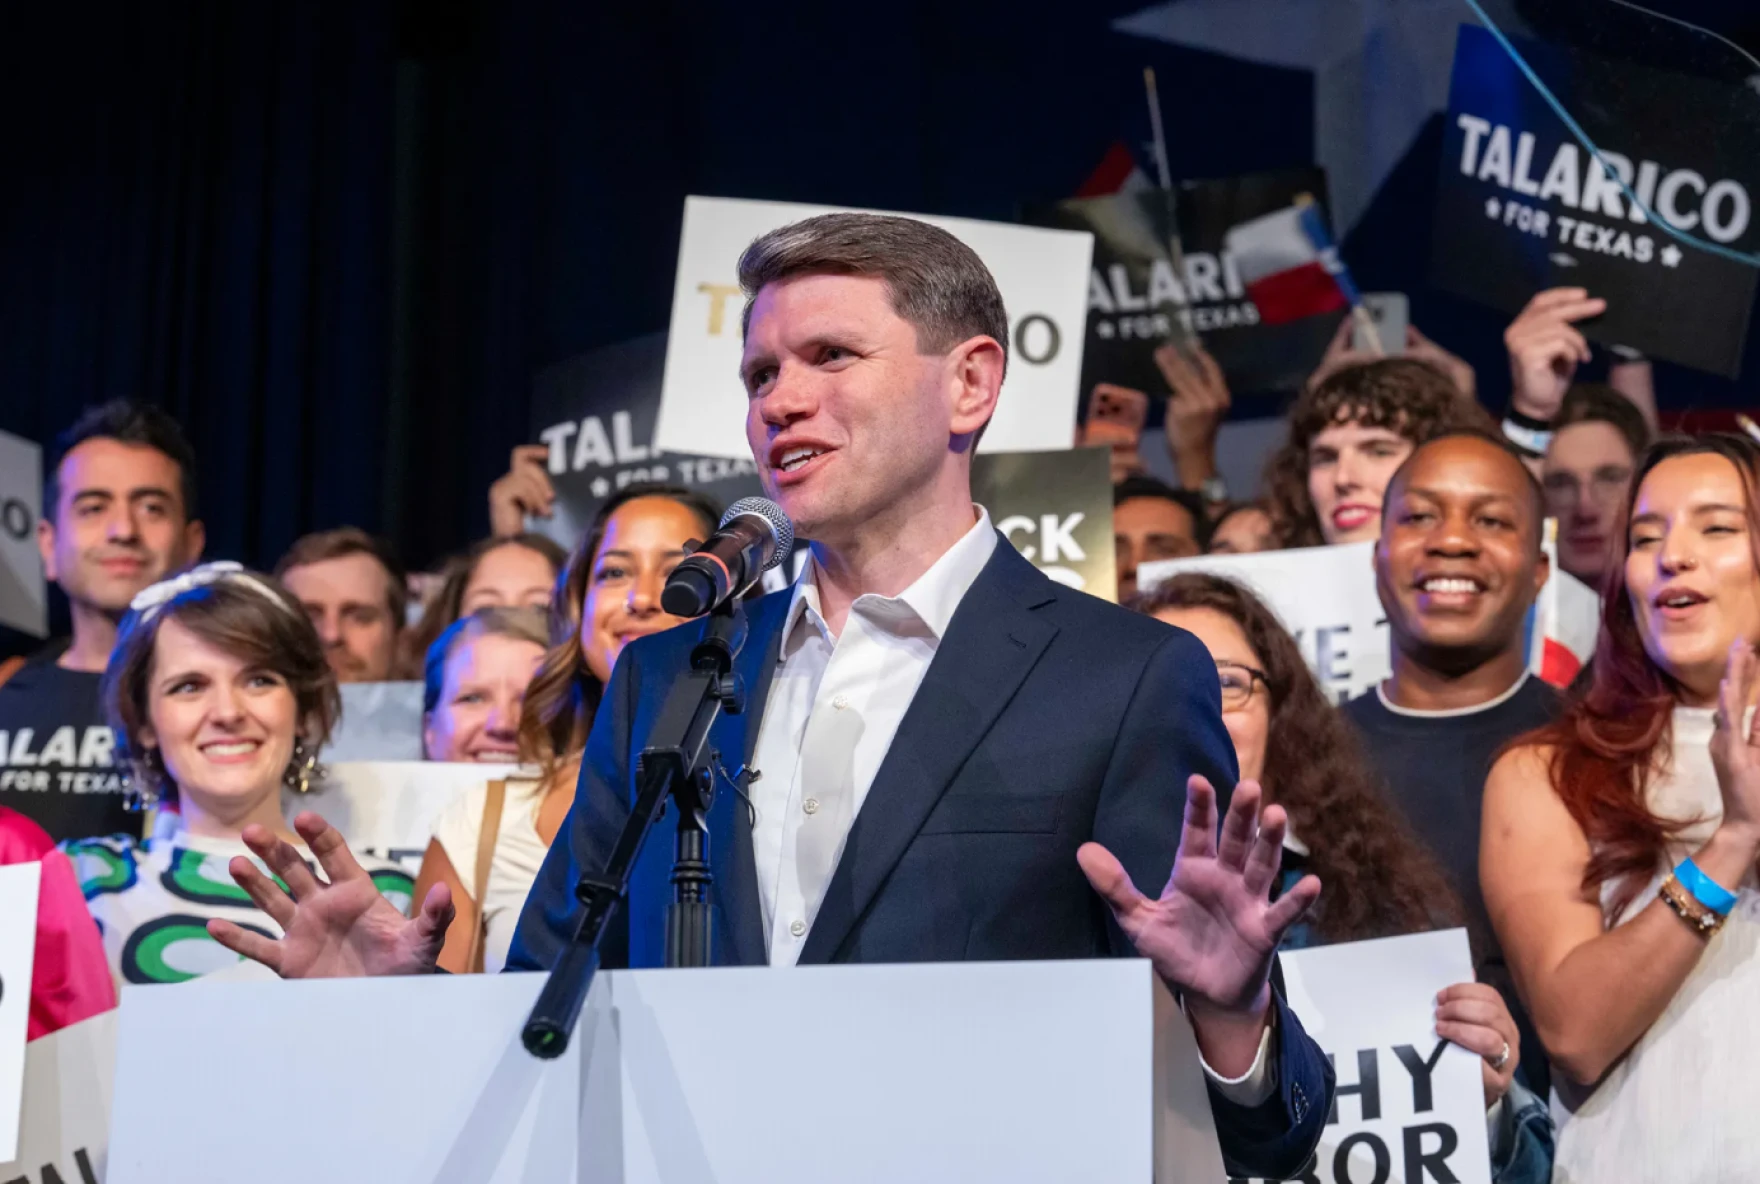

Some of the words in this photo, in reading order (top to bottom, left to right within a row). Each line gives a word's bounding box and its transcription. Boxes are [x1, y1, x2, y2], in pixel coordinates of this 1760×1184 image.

[1457, 113, 1751, 243] TALARICO
[1504, 200, 1551, 238] FOR
[1557, 216, 1654, 263] TEXAS
[1118, 313, 1171, 340] FOR
[1176, 301, 1260, 332] TEXAS
[540, 411, 663, 475] TAL
[0, 726, 115, 767] LAR
[0, 770, 50, 792] FOR
